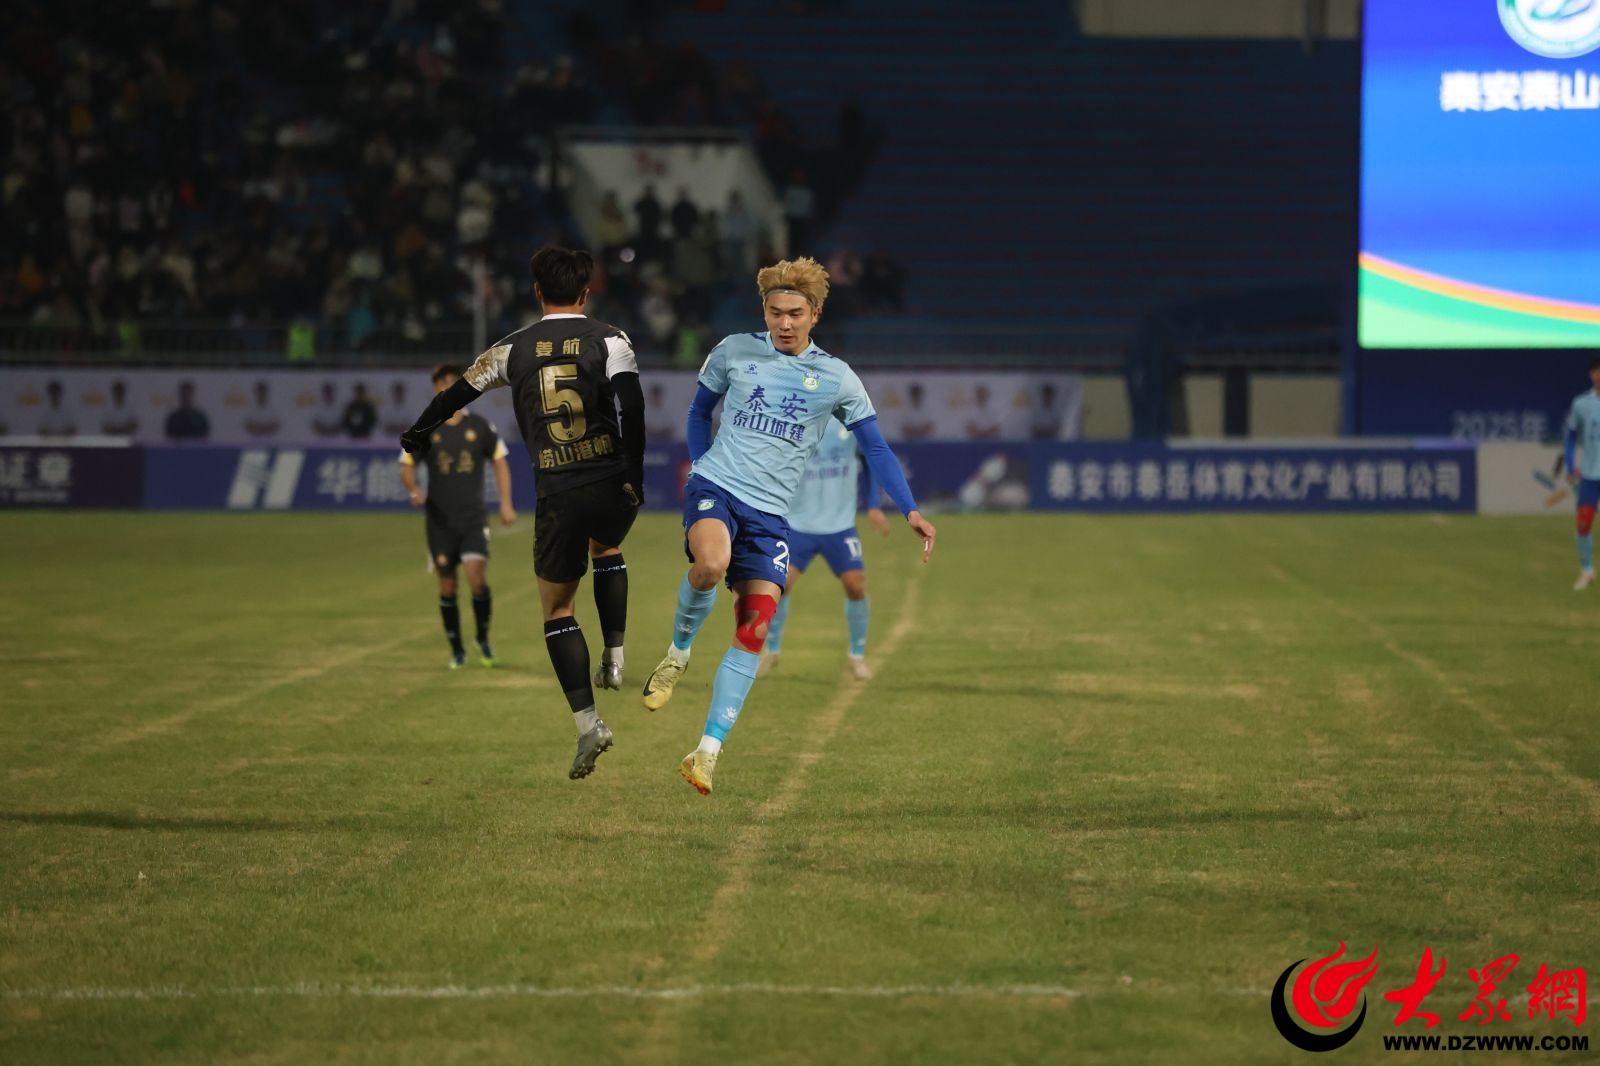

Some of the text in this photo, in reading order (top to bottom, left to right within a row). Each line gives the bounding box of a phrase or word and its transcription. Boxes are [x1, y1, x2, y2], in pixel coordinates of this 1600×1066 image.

[536, 338, 580, 358] 姜航
[539, 364, 587, 445] 5
[745, 384, 808, 421] 泰安
[733, 409, 806, 442] 泰山城建
[773, 541, 790, 571] 2
